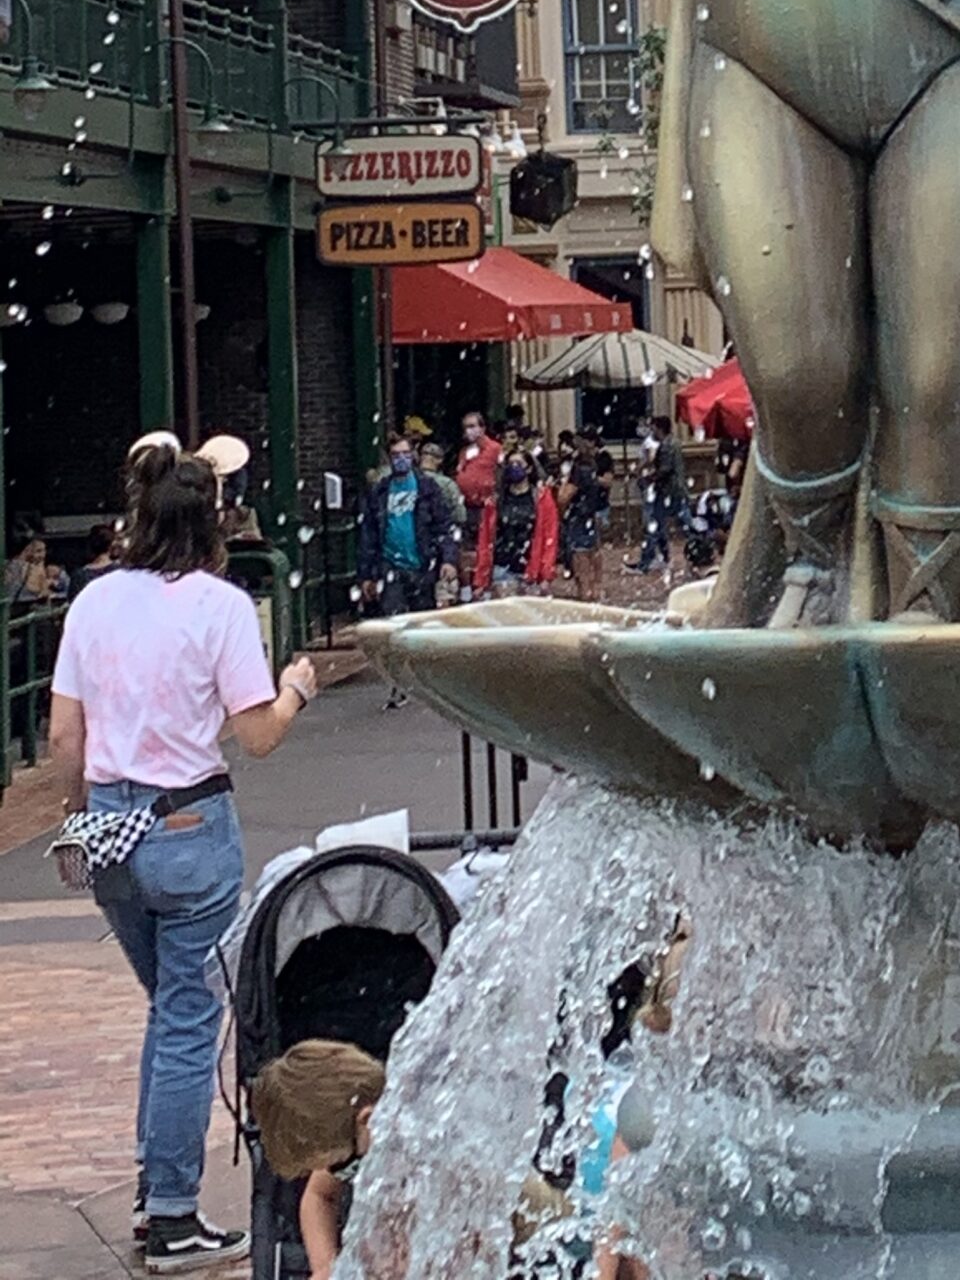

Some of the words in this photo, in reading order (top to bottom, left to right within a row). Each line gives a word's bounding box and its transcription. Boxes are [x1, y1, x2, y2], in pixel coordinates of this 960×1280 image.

[323, 149, 472, 185] PZZERIZZO
[330, 220, 396, 251] PIZZA
[412, 218, 470, 248] BEER
